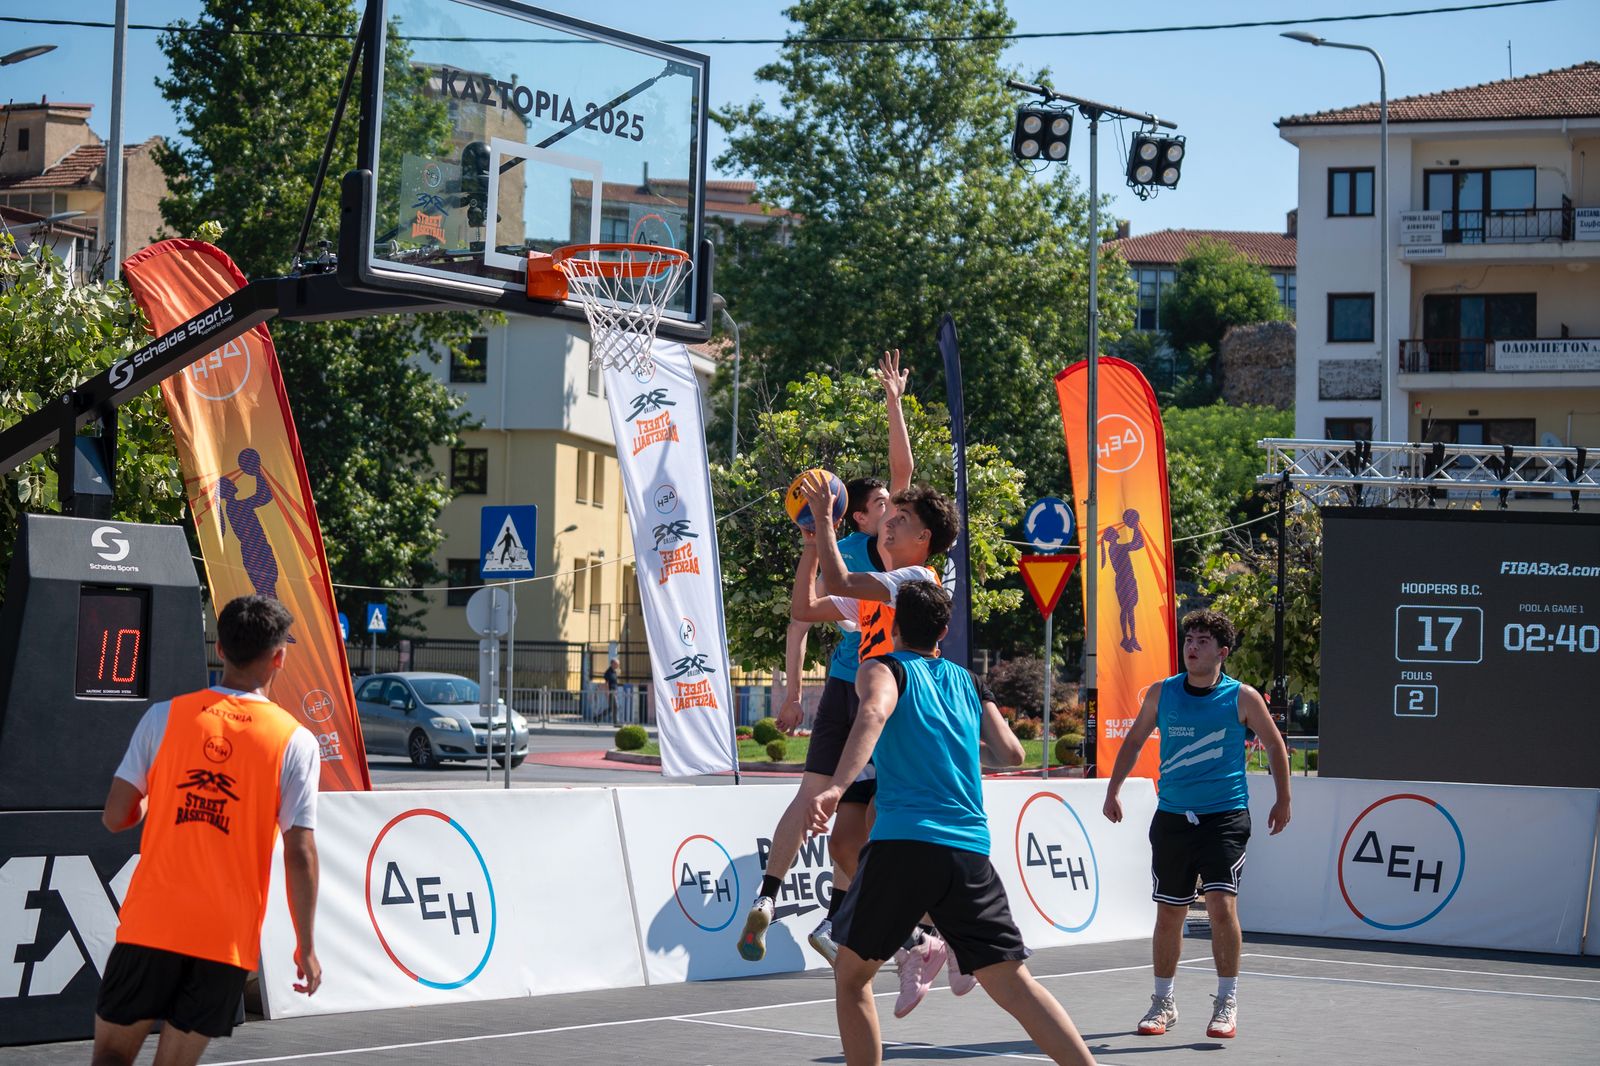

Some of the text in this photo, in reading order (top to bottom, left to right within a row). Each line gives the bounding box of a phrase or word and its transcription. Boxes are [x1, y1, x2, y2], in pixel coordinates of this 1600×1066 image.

[440, 68, 645, 142] ΚΑΣΤΟΡΙΑ 2025
[134, 330, 186, 368] Schelde
[90, 563, 116, 571] Schelde
[1401, 583, 1483, 595] HOOPERS B.C.
[1519, 604, 1543, 613] POOL
[1544, 604, 1550, 613] A
[1552, 605, 1577, 613] GAME
[1417, 616, 1463, 652] 17
[1503, 623, 1600, 653] 02:40
[98, 629, 140, 683] 10
[1401, 671, 1432, 680] FOULS
[1408, 690, 1424, 710] 2
[185, 791, 228, 814] STREET
[175, 806, 230, 834] BASKETBALL
[1026, 832, 1089, 891] ΔΕΗ
[1352, 830, 1443, 893] ΔΕΗ
[381, 861, 480, 935] ΔΕΗ
[680, 863, 731, 902] ΔΕΗ
